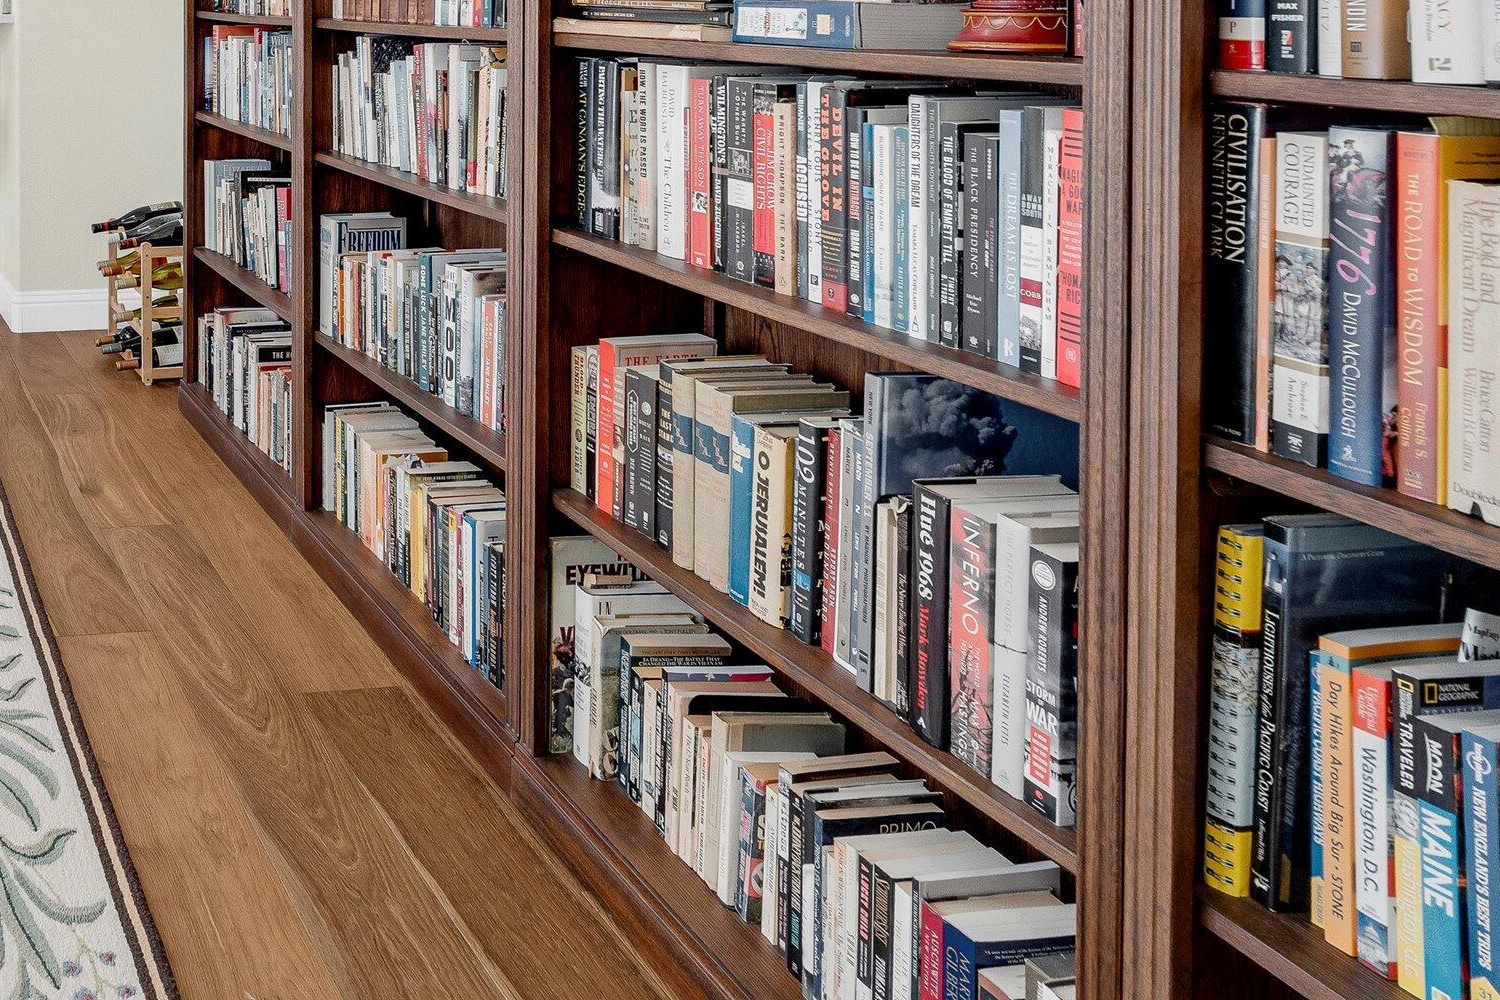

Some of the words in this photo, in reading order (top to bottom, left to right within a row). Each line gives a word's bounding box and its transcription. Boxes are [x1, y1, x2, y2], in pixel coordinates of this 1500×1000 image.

[717, 86, 725, 164] WILMINGTON'S
[821, 94, 829, 139] THE
[832, 107, 842, 176] DEVIL
[910, 102, 920, 149] DAUGHTERS
[943, 136, 953, 156] THE
[943, 158, 953, 185] BLOOD
[1211, 113, 1227, 198] KENNETH
[664, 184, 672, 232] Children
[821, 147, 829, 221] GROVE
[832, 186, 842, 212] IN
[970, 168, 978, 204] BLACK
[1224, 113, 1248, 265] CIVILISATION
[1283, 142, 1301, 226] COURAGE
[1301, 145, 1314, 229] UNDAUNTED
[943, 205, 953, 239] EMMETT
[1021, 208, 1042, 220] SOUTH
[1211, 201, 1226, 258] CLARK
[1404, 201, 1423, 261] ROAD
[942, 241, 952, 263] TILL
[970, 206, 979, 278] PRESIDENCY
[1329, 208, 1382, 296] 1776
[1462, 198, 1480, 293] Magnificent
[1020, 288, 1042, 300] COBB
[1342, 291, 1363, 338] DAVID
[1402, 288, 1424, 388] WISDOM
[1462, 297, 1480, 355] Dream
[798, 433, 815, 484] 102
[863, 432, 874, 502] SEPTEMBER
[752, 474, 770, 599] JERUSALEM!
[797, 485, 808, 570] MINUTES
[918, 550, 935, 601] 1968
[962, 517, 980, 635] INFERNO
[917, 604, 930, 645] Mark
[1037, 595, 1048, 633] ANDREW
[916, 650, 929, 709] Bowden
[1036, 633, 1047, 675] ROBERTS
[1260, 609, 1279, 704] LIGHTHOUSES
[1026, 680, 1056, 707] STORM
[1326, 680, 1342, 709] Day
[1438, 684, 1470, 692] NATIONAL
[1438, 691, 1479, 701] GEOGRAPHIC
[959, 690, 968, 758] HASTINGS
[1026, 700, 1059, 736] WAR
[1259, 716, 1276, 772] PACIFIC
[1329, 711, 1343, 750] Hikes
[1326, 754, 1343, 807] Around
[1400, 722, 1414, 790] TRAVELER
[1427, 739, 1443, 794] MOON
[1257, 772, 1275, 813] COAST
[1361, 746, 1379, 856] Washington,
[1328, 810, 1343, 835] Big
[1330, 839, 1343, 863] Sur
[1361, 857, 1379, 892] D.C.
[1420, 806, 1454, 918] MAINE
[1332, 877, 1344, 920] STONE
[931, 930, 939, 999] AUSCHWITZ
